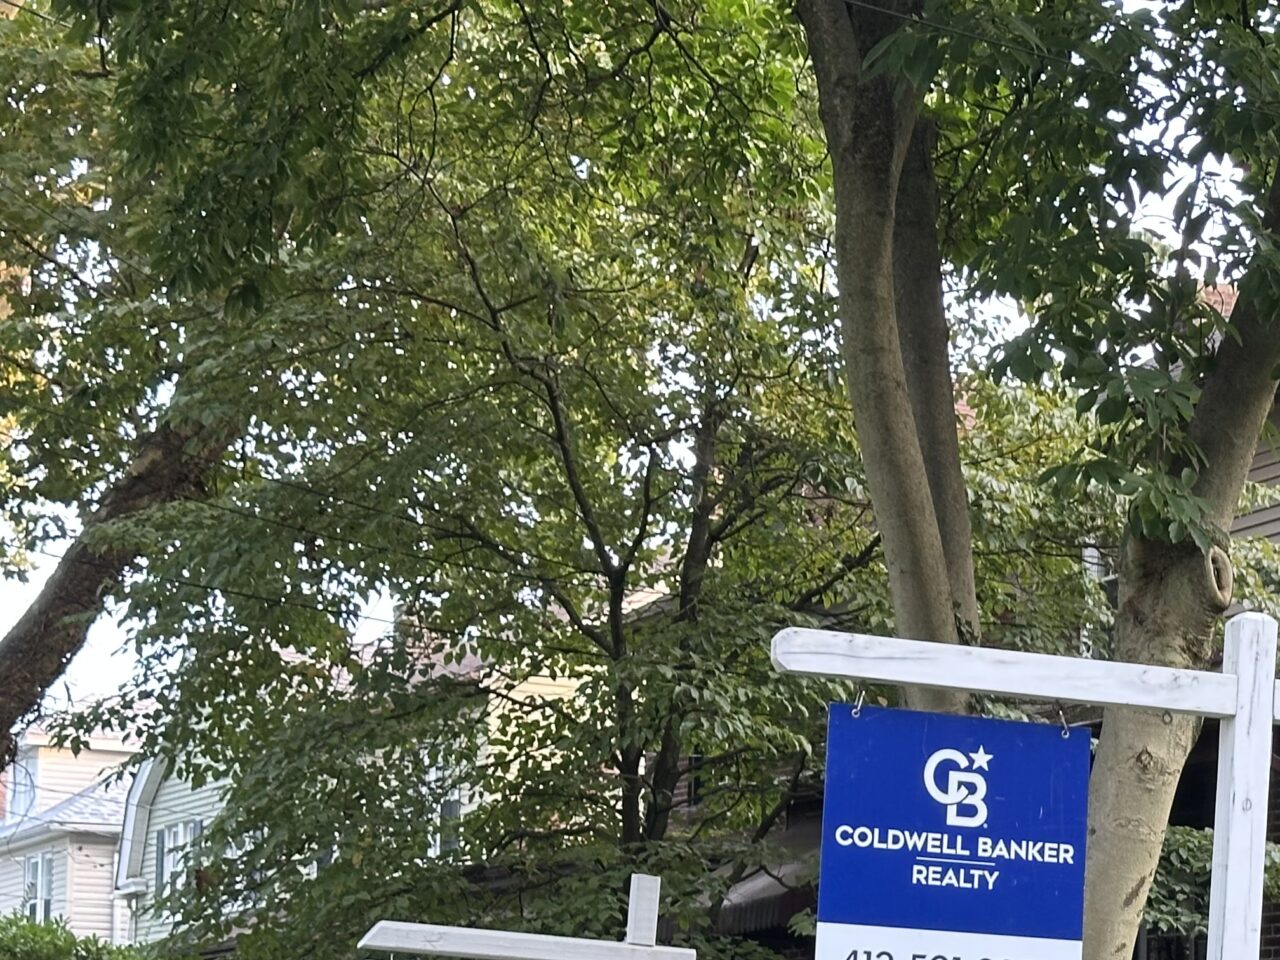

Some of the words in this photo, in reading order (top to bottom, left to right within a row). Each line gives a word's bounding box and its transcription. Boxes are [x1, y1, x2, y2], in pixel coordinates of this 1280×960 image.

[835, 824, 970, 856] COLDWELL
[977, 837, 1074, 865] BANKER
[912, 864, 999, 890] REALTY
